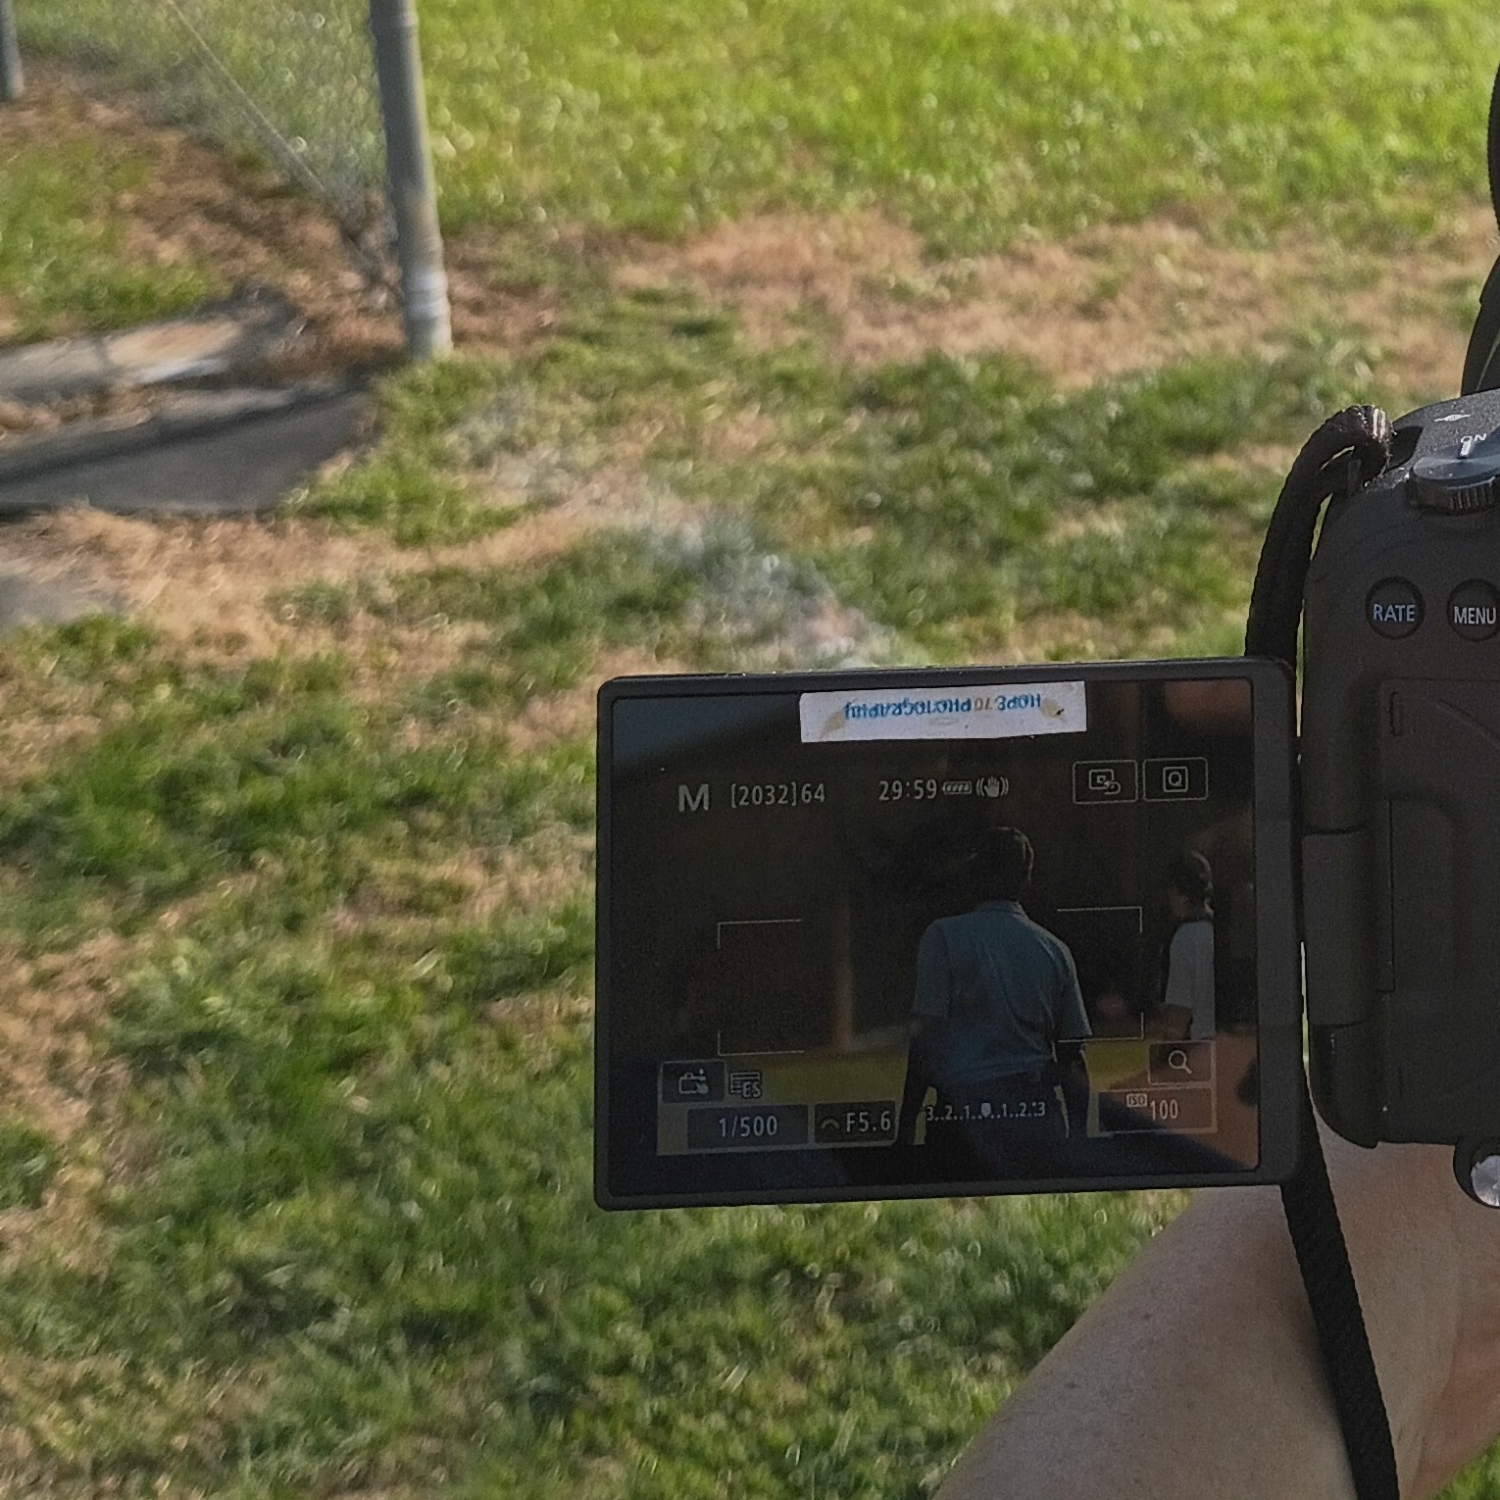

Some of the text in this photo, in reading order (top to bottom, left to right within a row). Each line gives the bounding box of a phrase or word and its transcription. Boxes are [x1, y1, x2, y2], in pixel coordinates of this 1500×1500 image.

[1372, 602, 1416, 623] RATE
[1453, 605, 1497, 625] MENU
[677, 783, 710, 812] M
[878, 779, 938, 801] 29:59
[718, 1115, 778, 1138] 1/500
[846, 1110, 892, 1133] F5.6
[1150, 1099, 1179, 1120] 100
